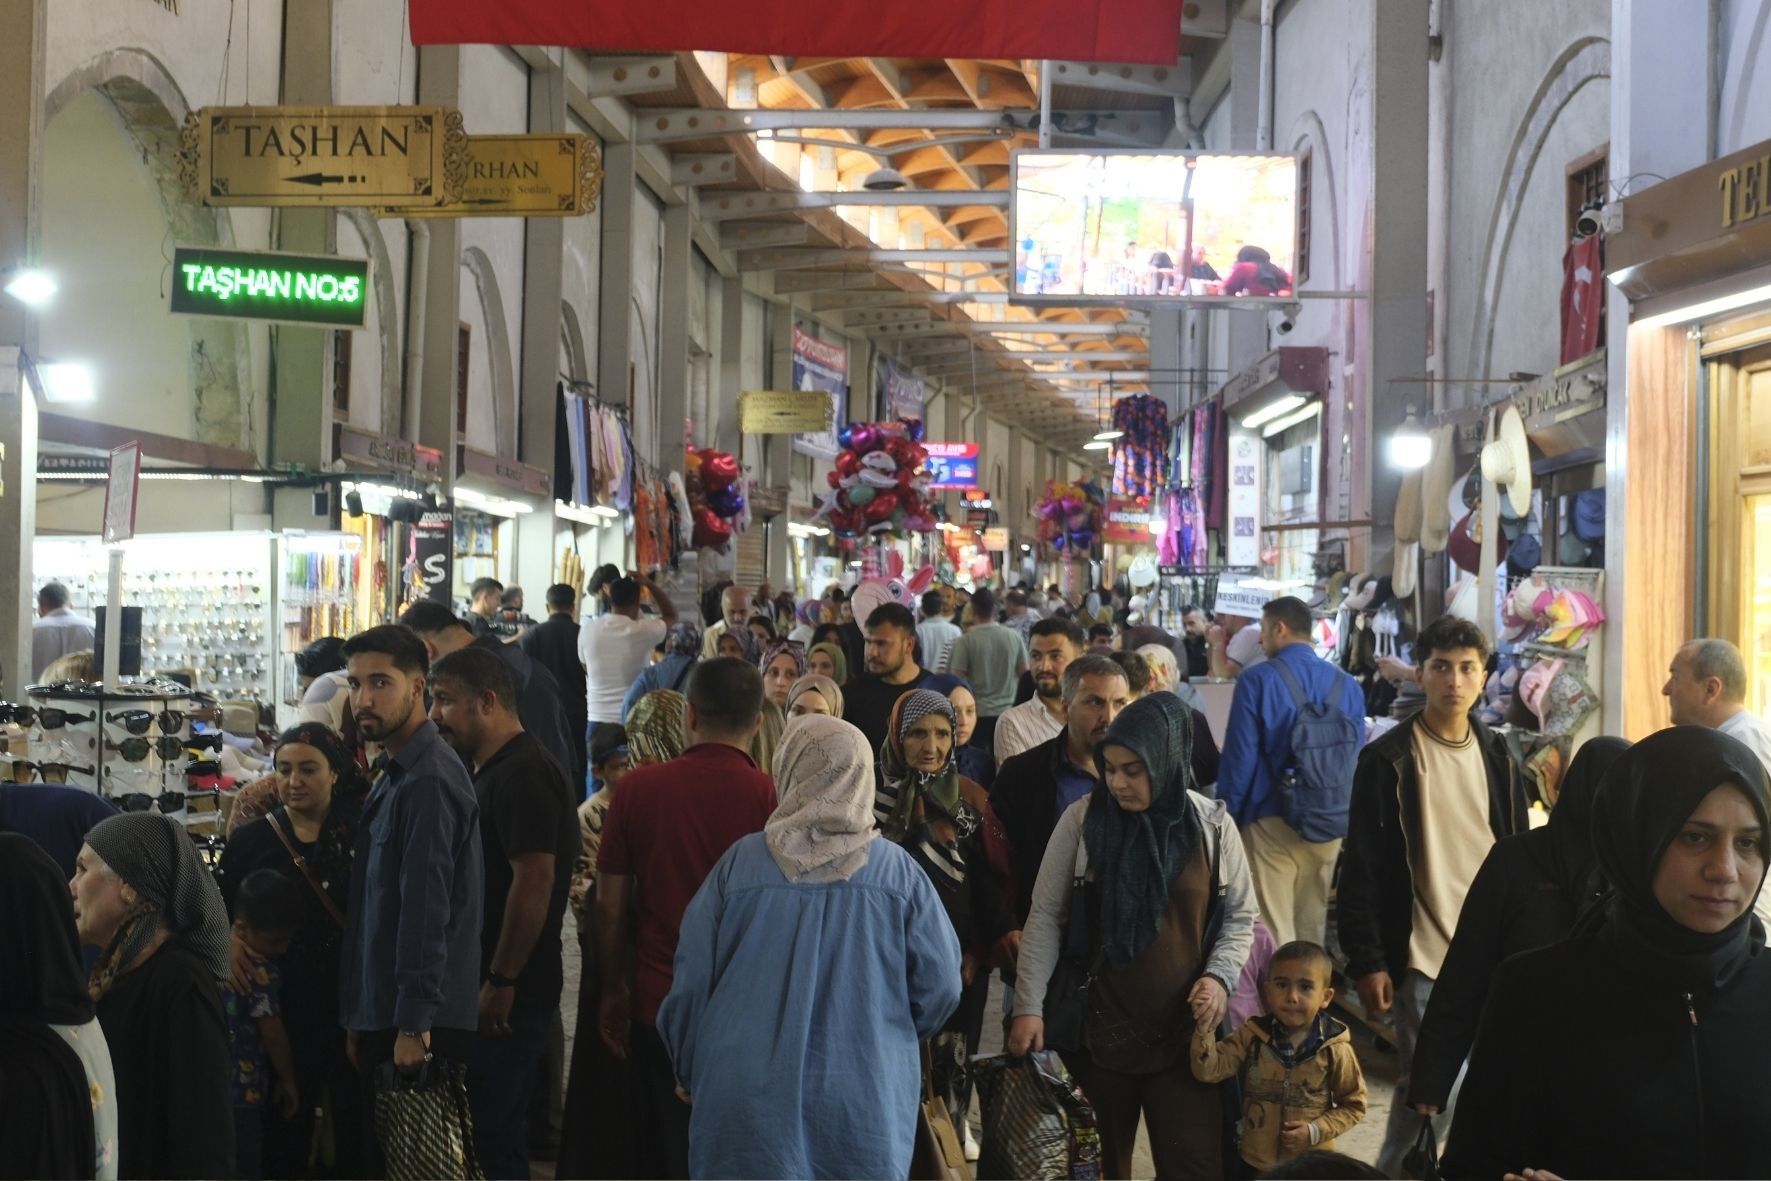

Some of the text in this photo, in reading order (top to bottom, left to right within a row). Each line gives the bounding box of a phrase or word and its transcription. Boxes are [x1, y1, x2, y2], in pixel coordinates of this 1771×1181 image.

[235, 124, 410, 164] TAŞHAN
[182, 264, 360, 302] TAŞHAN NO:5
